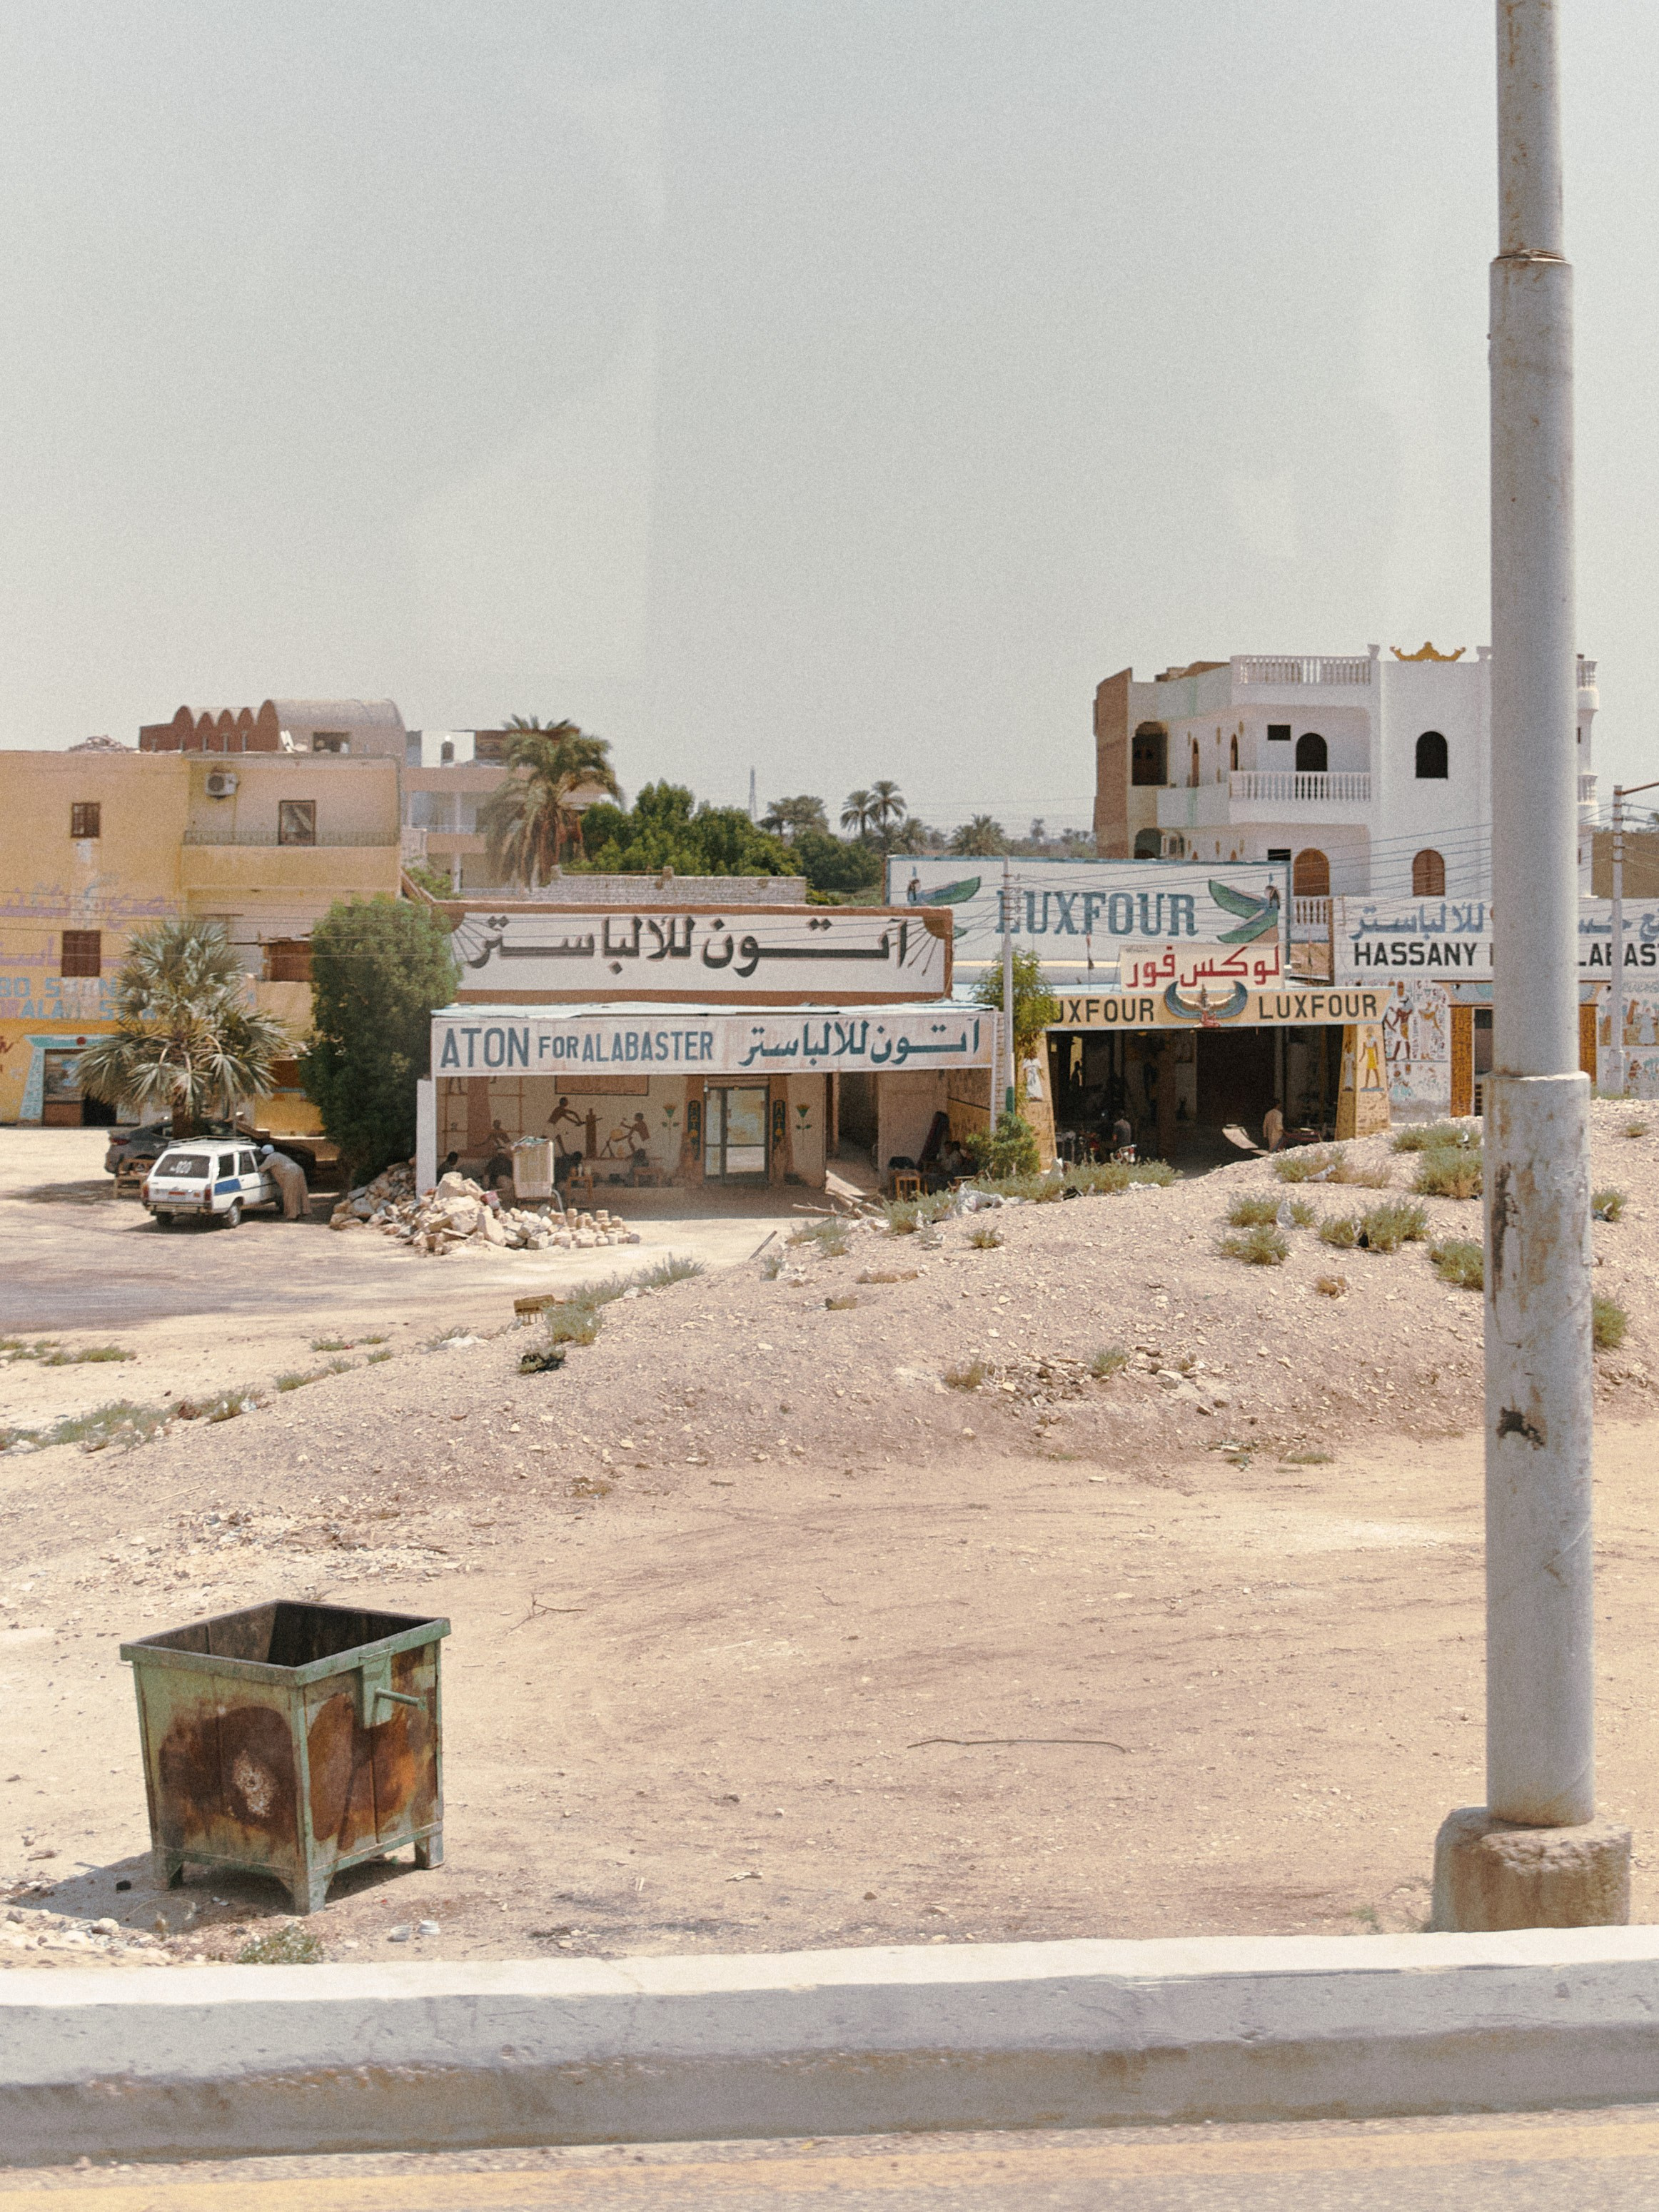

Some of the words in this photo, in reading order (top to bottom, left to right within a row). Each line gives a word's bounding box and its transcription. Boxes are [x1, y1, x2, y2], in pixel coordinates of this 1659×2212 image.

[995, 890, 1199, 936] LUXFOUR
[1126, 946, 1175, 987] فور
[1179, 944, 1280, 987] لوكس
[1354, 942, 1477, 966] HASSANY
[1052, 998, 1154, 1024] UXFOUR
[1259, 994, 1377, 1019] LUXFOUR
[440, 1027, 529, 1068] ATON
[539, 1036, 578, 1059] FOR
[582, 1031, 714, 1062] ALABASTER
